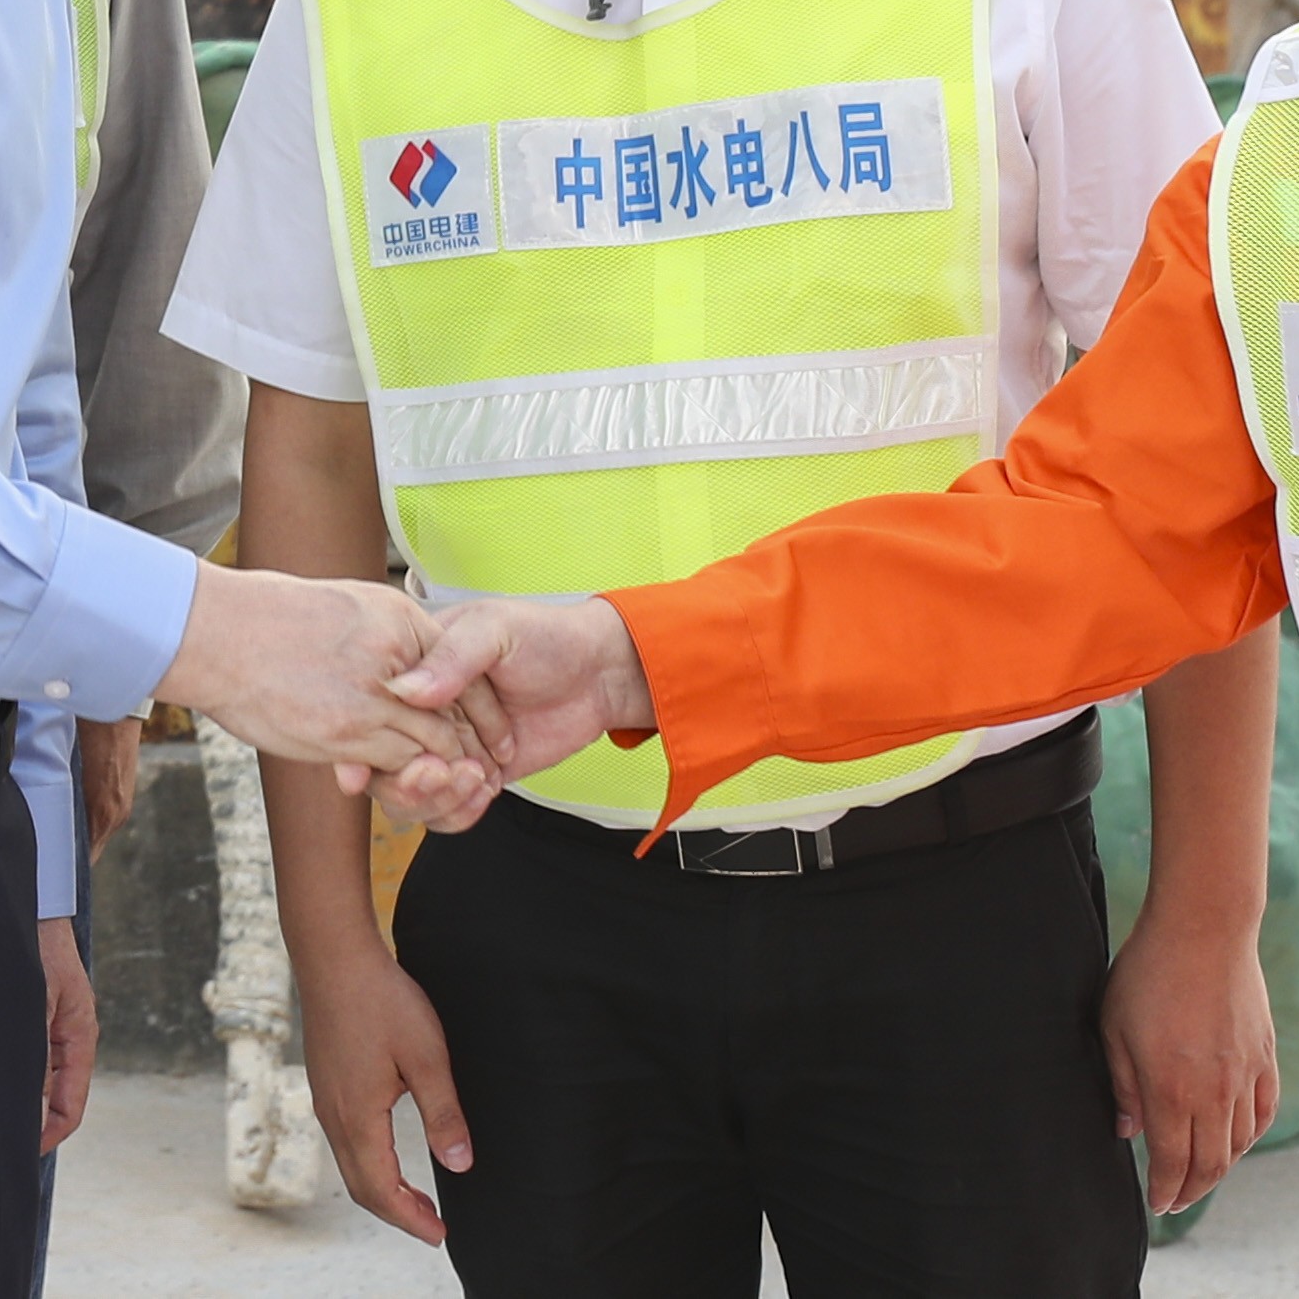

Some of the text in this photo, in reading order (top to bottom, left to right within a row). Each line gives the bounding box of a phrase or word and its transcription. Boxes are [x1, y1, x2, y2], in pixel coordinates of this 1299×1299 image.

[554, 101, 892, 229] 中国水电八局
[383, 212, 479, 245] 中国电建
[385, 235, 480, 258] POWERCHINA
